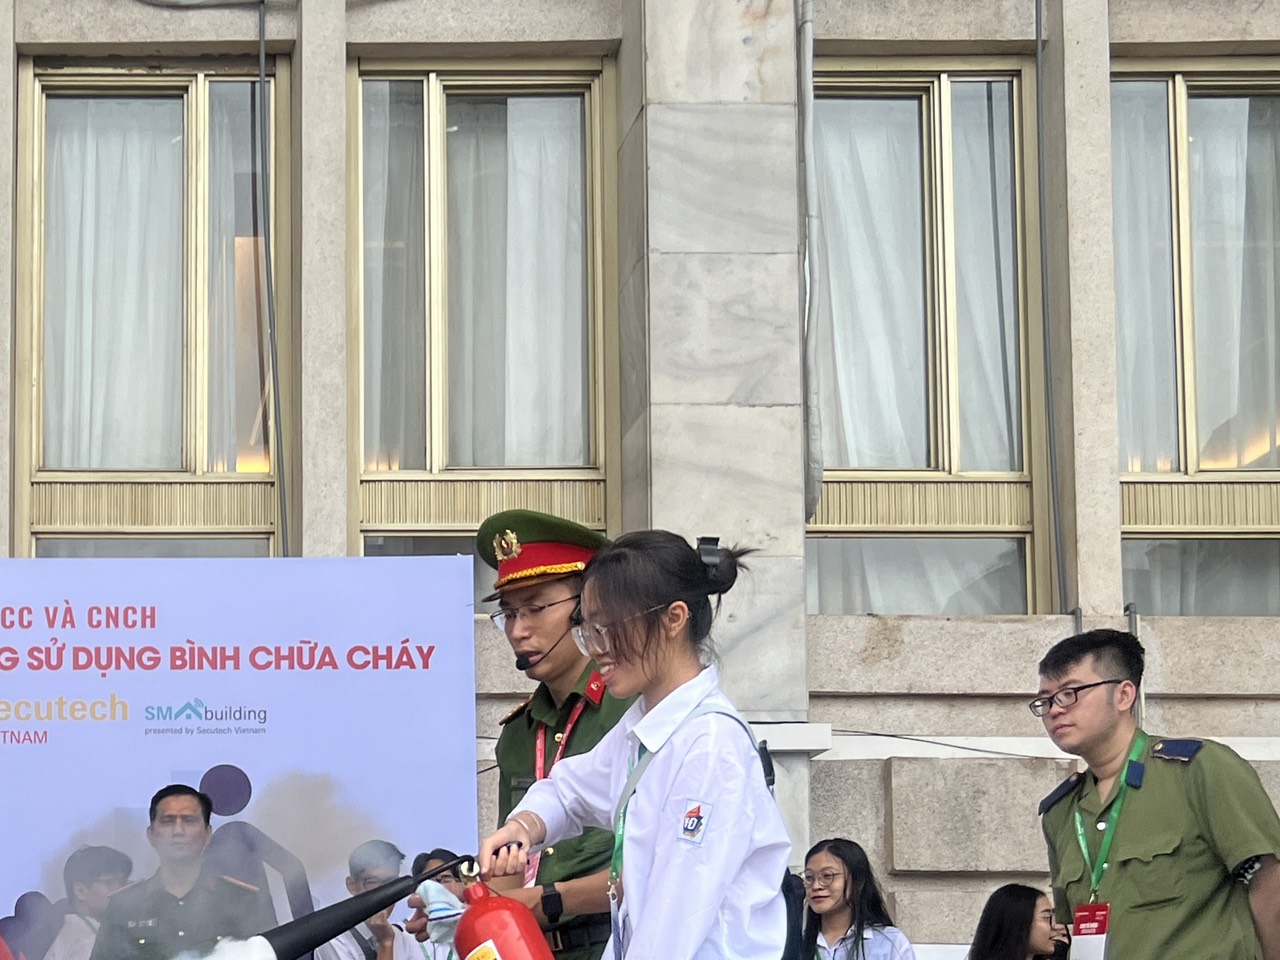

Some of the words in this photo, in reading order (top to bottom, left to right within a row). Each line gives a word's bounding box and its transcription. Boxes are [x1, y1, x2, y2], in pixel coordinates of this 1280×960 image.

[43, 599, 76, 629] VÀ
[87, 605, 156, 629] CNCH
[26, 636, 67, 671] SỬ
[72, 645, 162, 678] DỤNG
[169, 638, 241, 671] BÌNH
[248, 639, 340, 671] CHỮA
[346, 637, 436, 670] CHÁY
[144, 726, 184, 736] presented
[184, 726, 195, 736] by
[196, 726, 233, 735] Secutech
[233, 726, 267, 735] Vietnam
